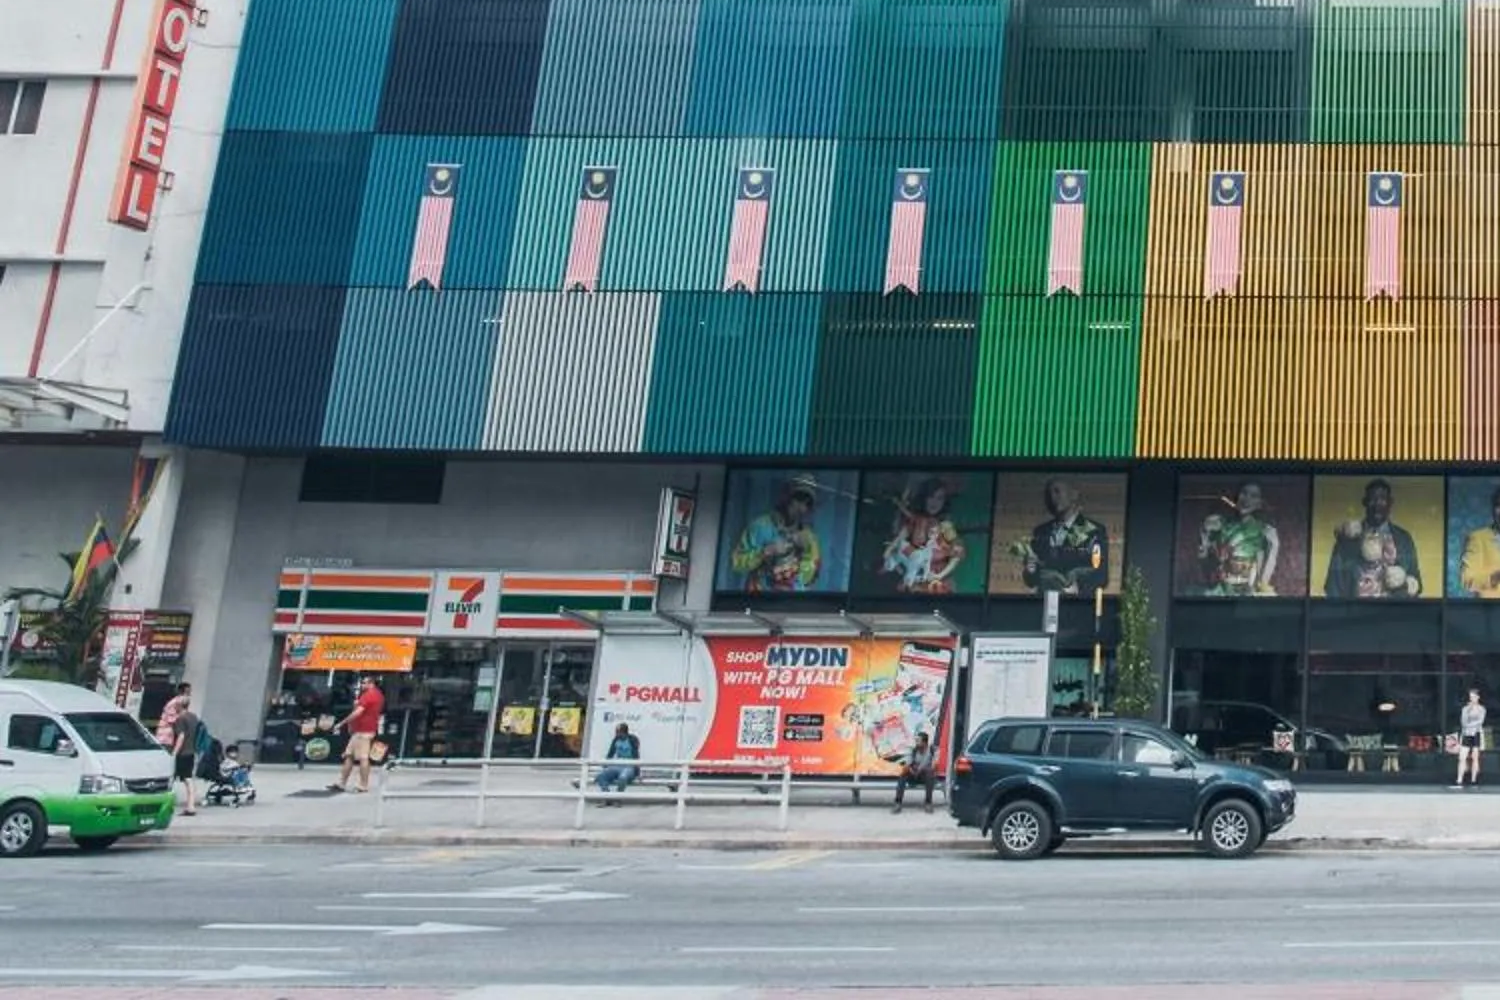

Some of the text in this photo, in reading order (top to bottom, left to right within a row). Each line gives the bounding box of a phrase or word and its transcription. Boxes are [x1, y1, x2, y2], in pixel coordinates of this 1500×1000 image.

[448, 576, 485, 629] 7
[727, 647, 849, 667] SHOP MYDIN
[723, 669, 845, 686] WITH PG MALL
[626, 686, 702, 702] PGMALL
[760, 686, 808, 699] NOW!
